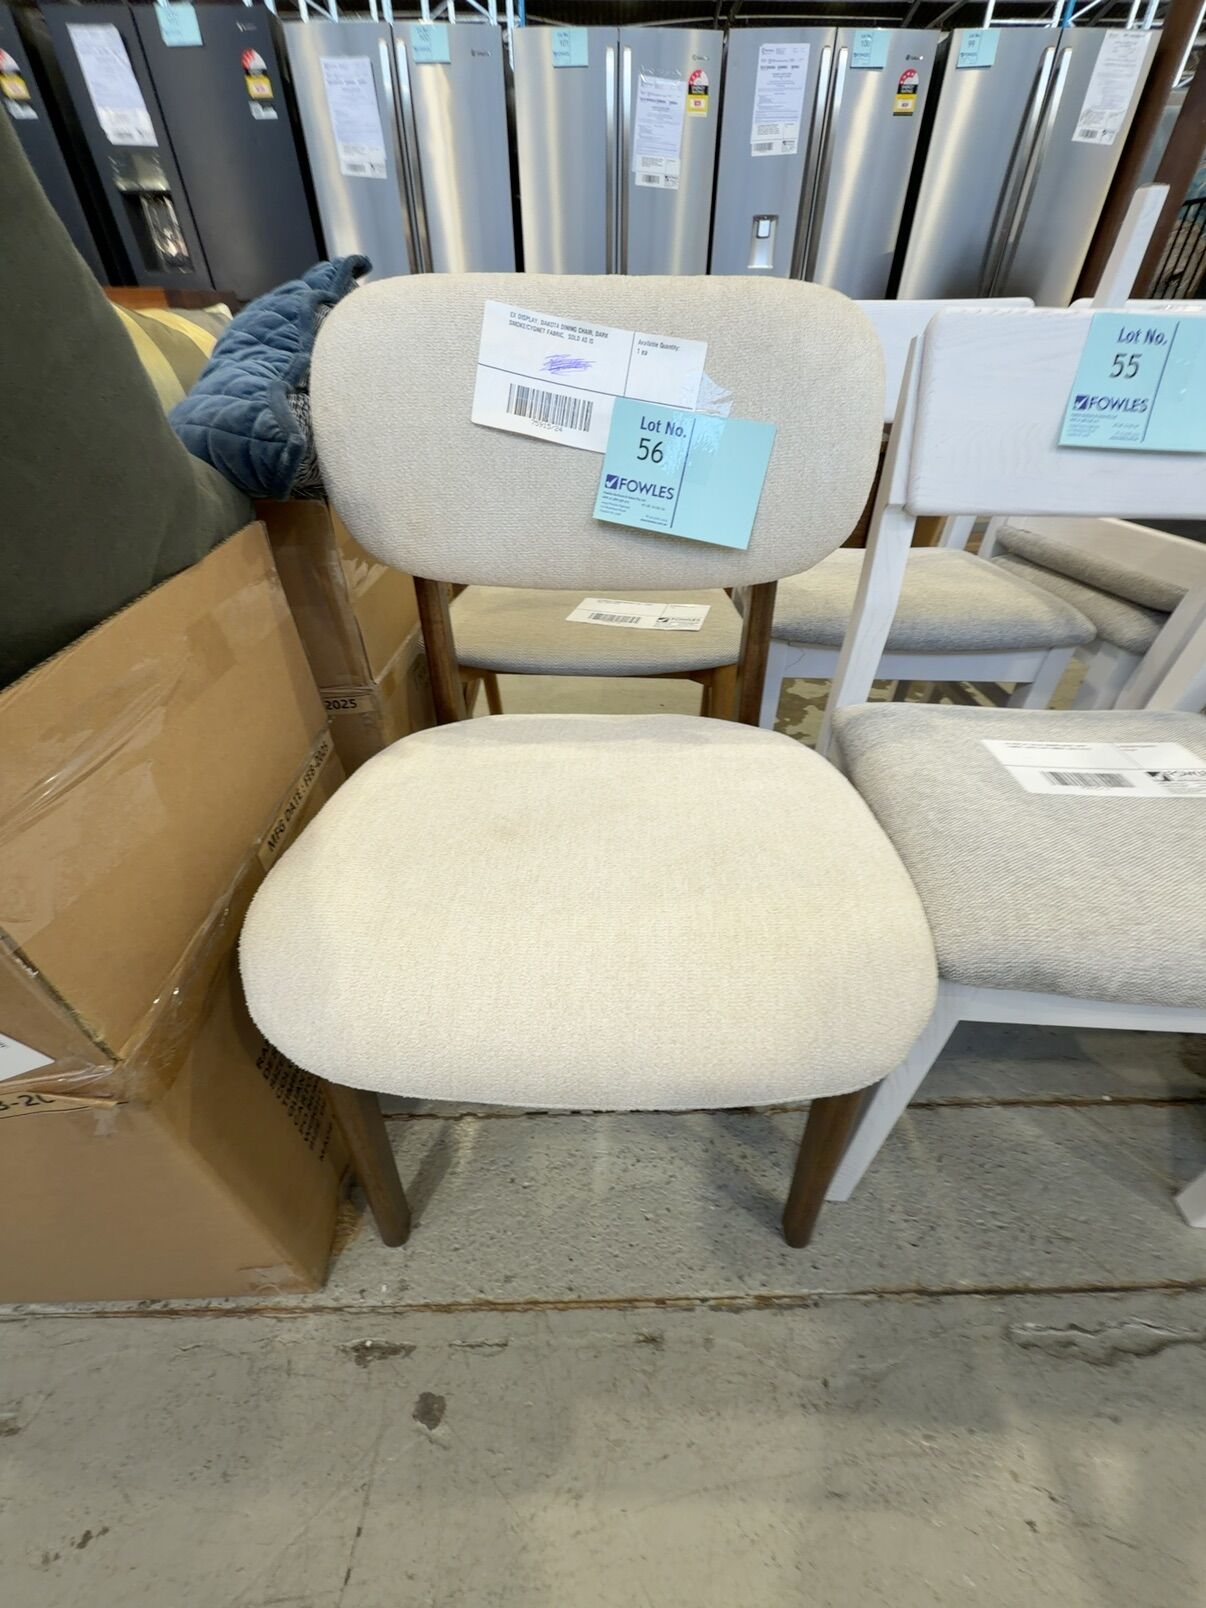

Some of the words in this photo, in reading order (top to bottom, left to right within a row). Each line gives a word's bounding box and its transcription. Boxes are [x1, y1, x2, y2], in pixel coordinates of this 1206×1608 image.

[540, 319, 559, 329] DAKOTA
[561, 324, 577, 333] DINING
[1117, 326, 1142, 344] Lot
[1143, 328, 1168, 346] No.
[638, 339, 659, 348] Available
[660, 342, 680, 352] Quantity:
[1109, 353, 1143, 379] 55
[1088, 395, 1149, 414] FOWLES
[640, 416, 661, 433] Lot
[665, 421, 687, 438] No.
[637, 437, 664, 464] 56
[618, 478, 675, 500] FOWLES
[267, 819, 287, 852] MFG
